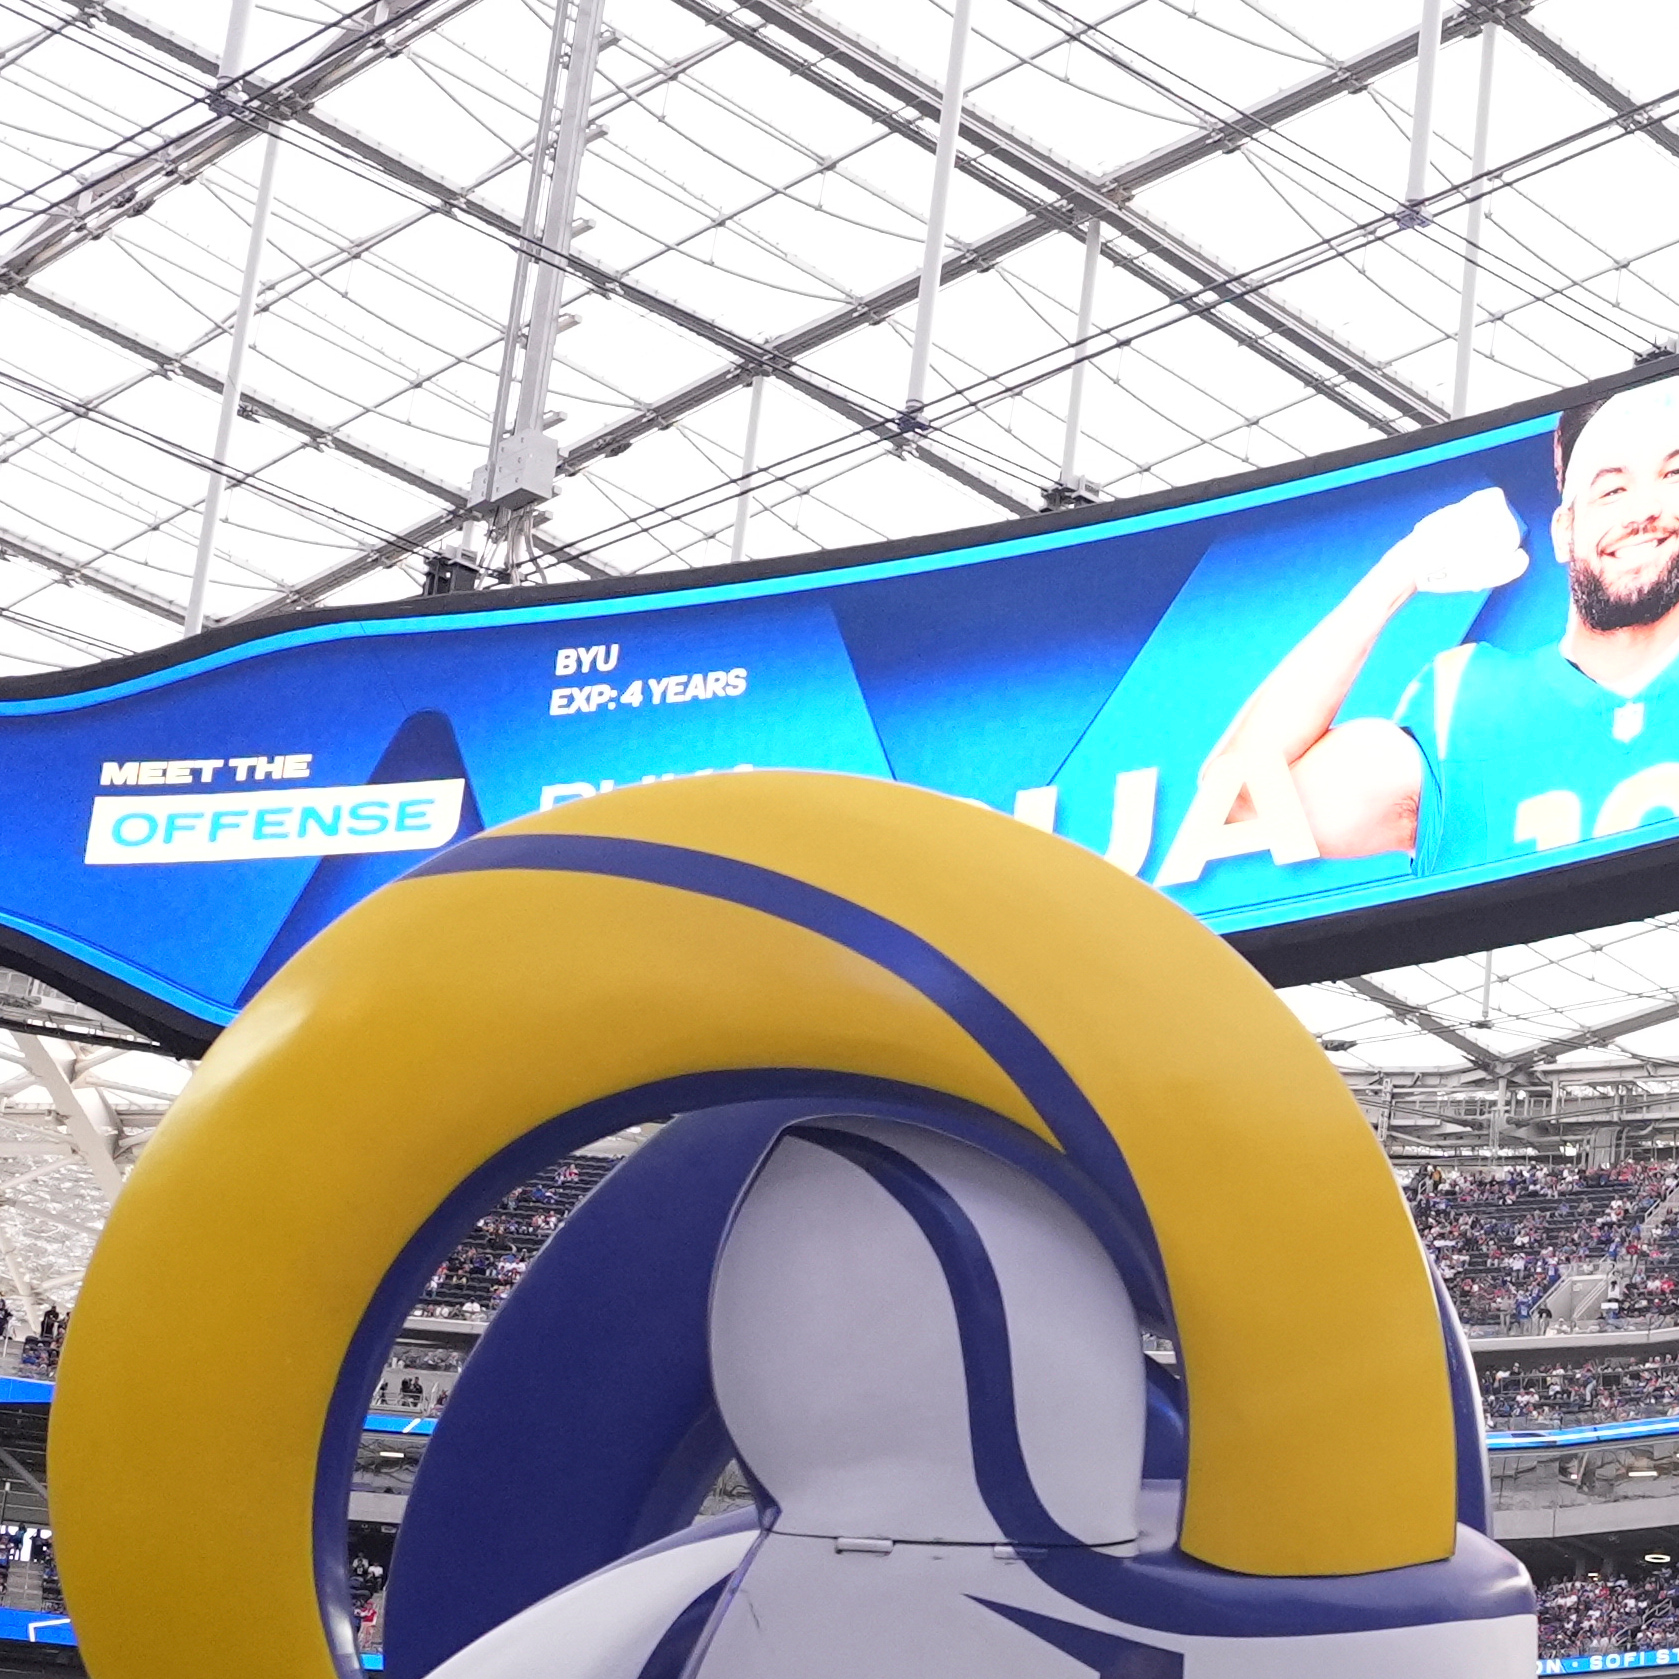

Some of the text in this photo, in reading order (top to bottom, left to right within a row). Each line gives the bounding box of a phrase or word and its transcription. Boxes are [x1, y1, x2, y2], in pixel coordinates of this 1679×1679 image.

[554, 644, 619, 676] BYU
[549, 667, 748, 716] EXP: 4 YEARS
[100, 753, 313, 786] MEET THE
[112, 798, 436, 848] OFFENSE
[1589, 1650, 1645, 1671] SOFI
